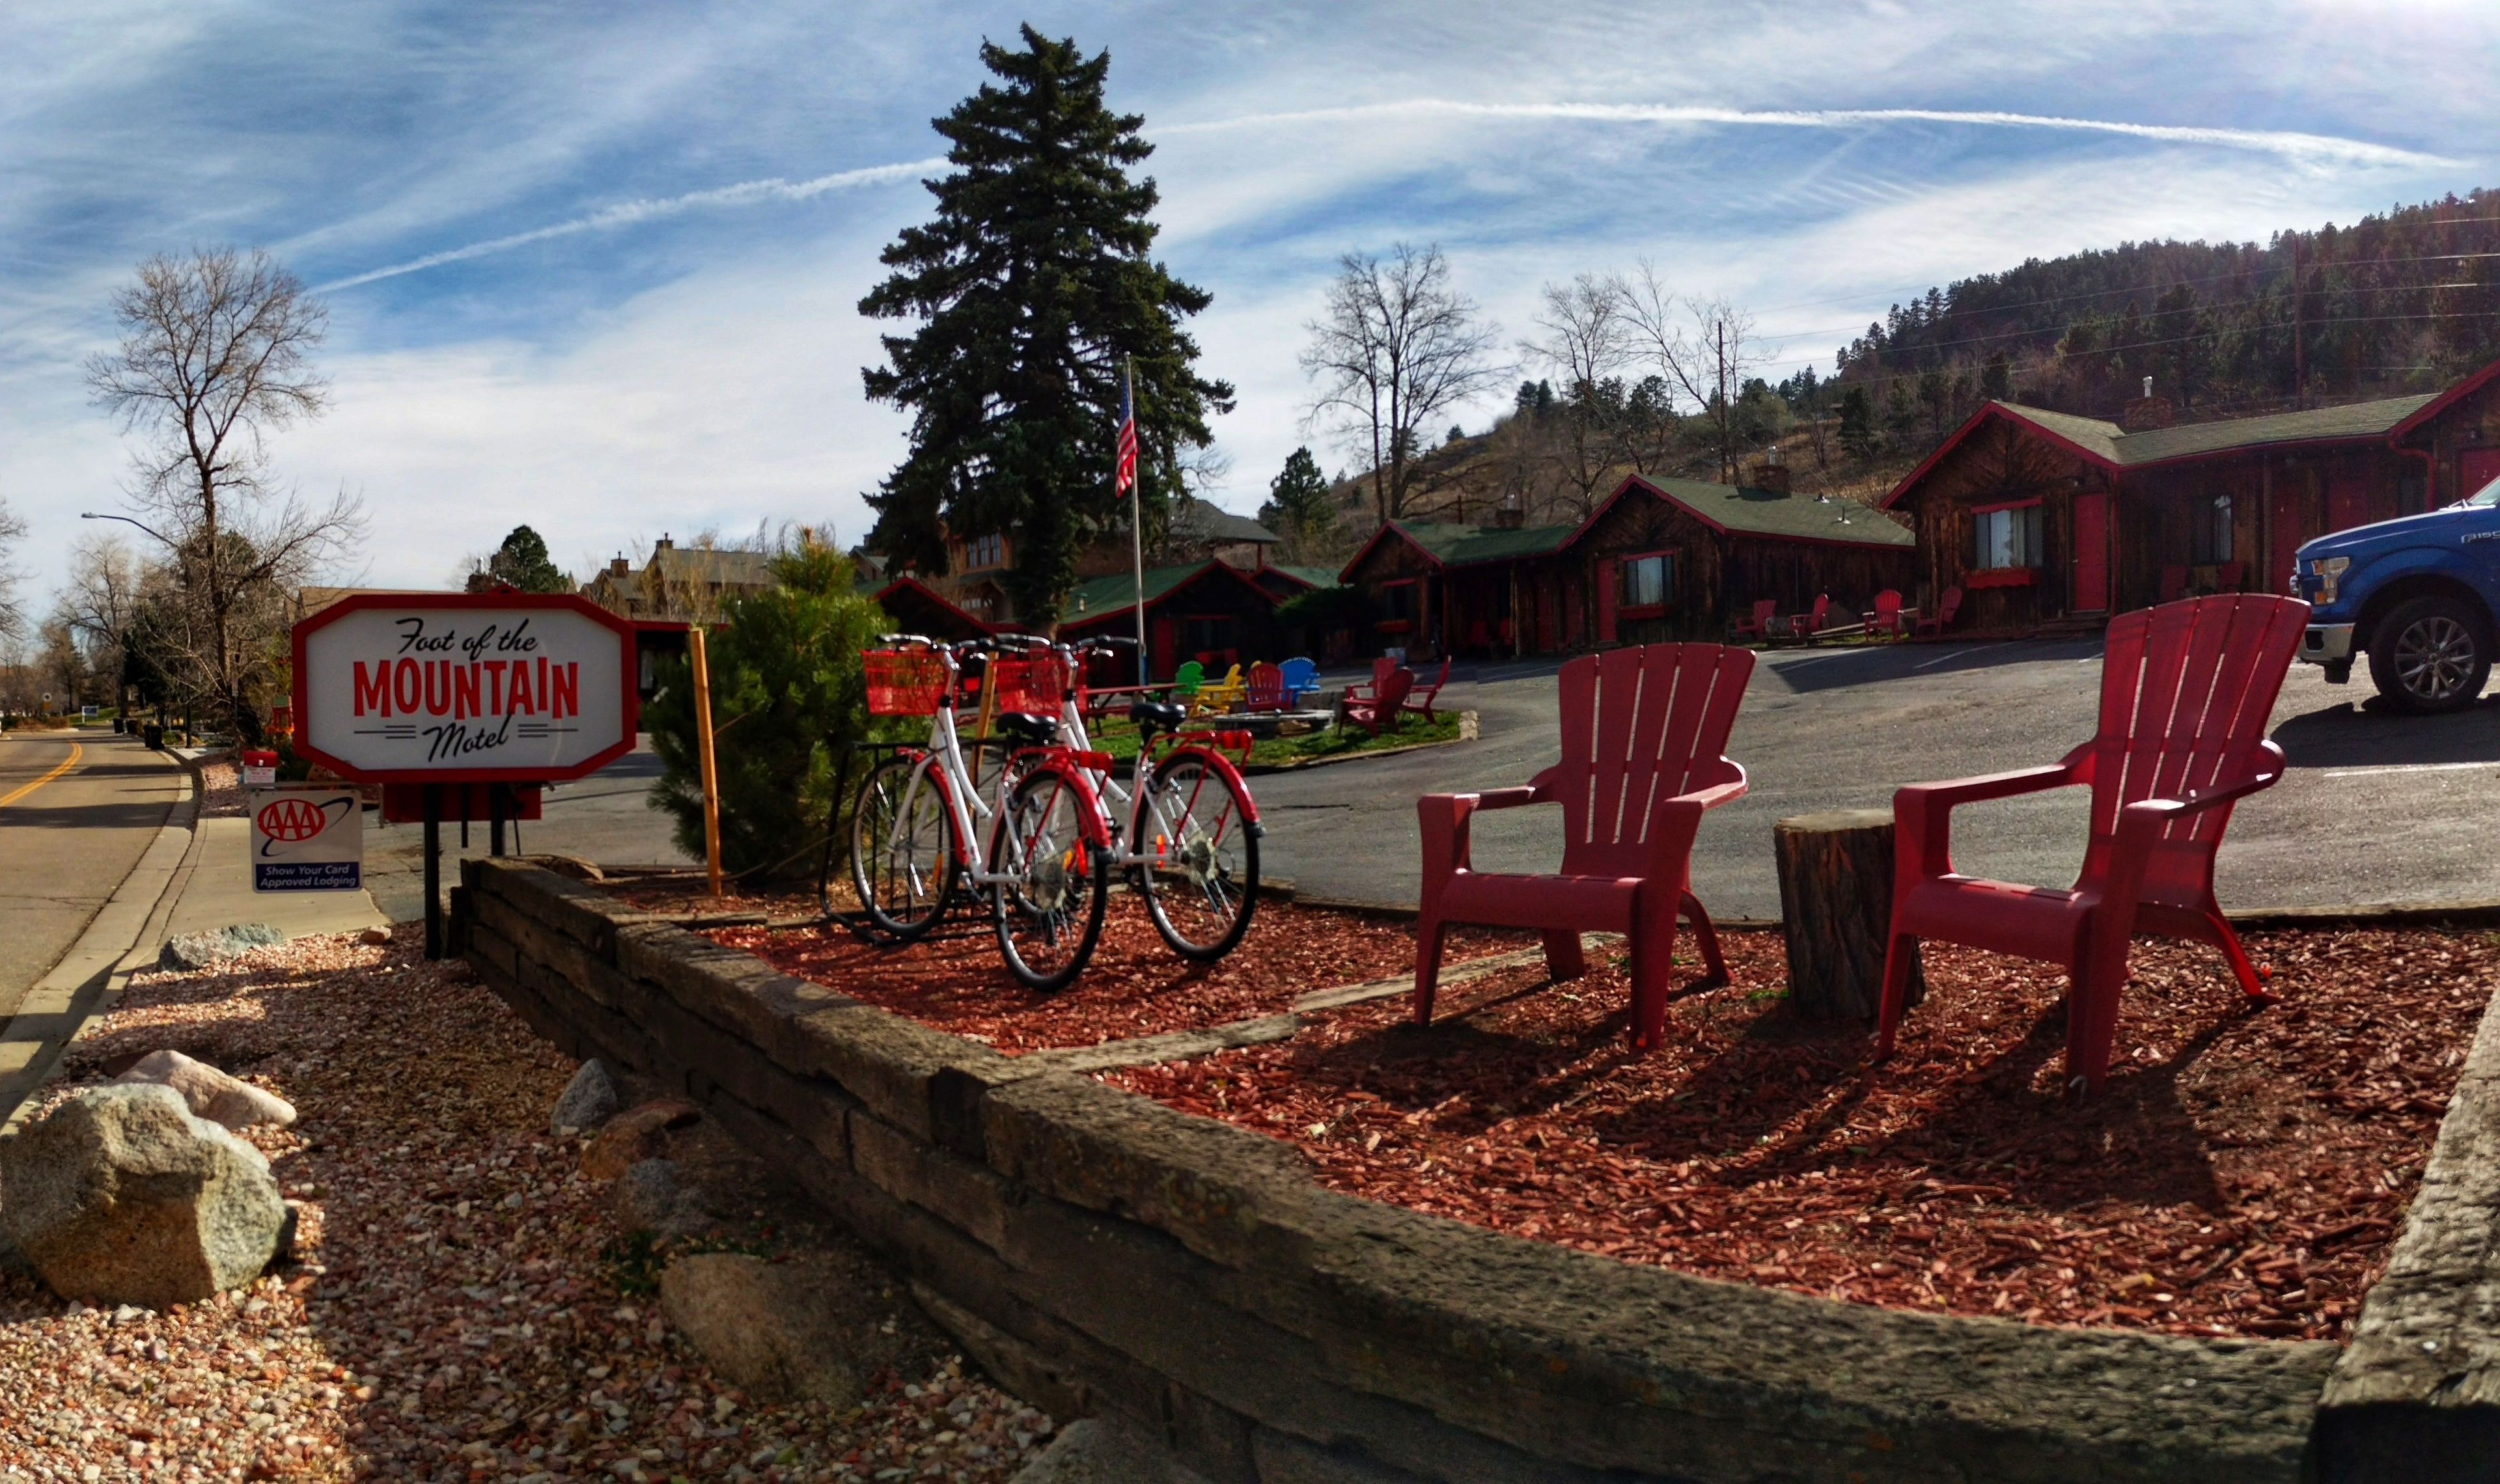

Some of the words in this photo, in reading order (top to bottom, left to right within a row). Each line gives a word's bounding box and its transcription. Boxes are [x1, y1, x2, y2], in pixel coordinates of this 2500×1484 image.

[395, 618, 455, 655] Foot
[462, 624, 497, 661] of
[497, 618, 538, 652] the
[354, 657, 578, 720] MOUNTAIN
[422, 713, 512, 762] Motel
[263, 800, 321, 840] AAA
[260, 876, 312, 888] Approved
[314, 876, 356, 887] Lodging
[266, 866, 295, 876] Show
[298, 866, 323, 875] Your
[325, 864, 350, 874] Card
